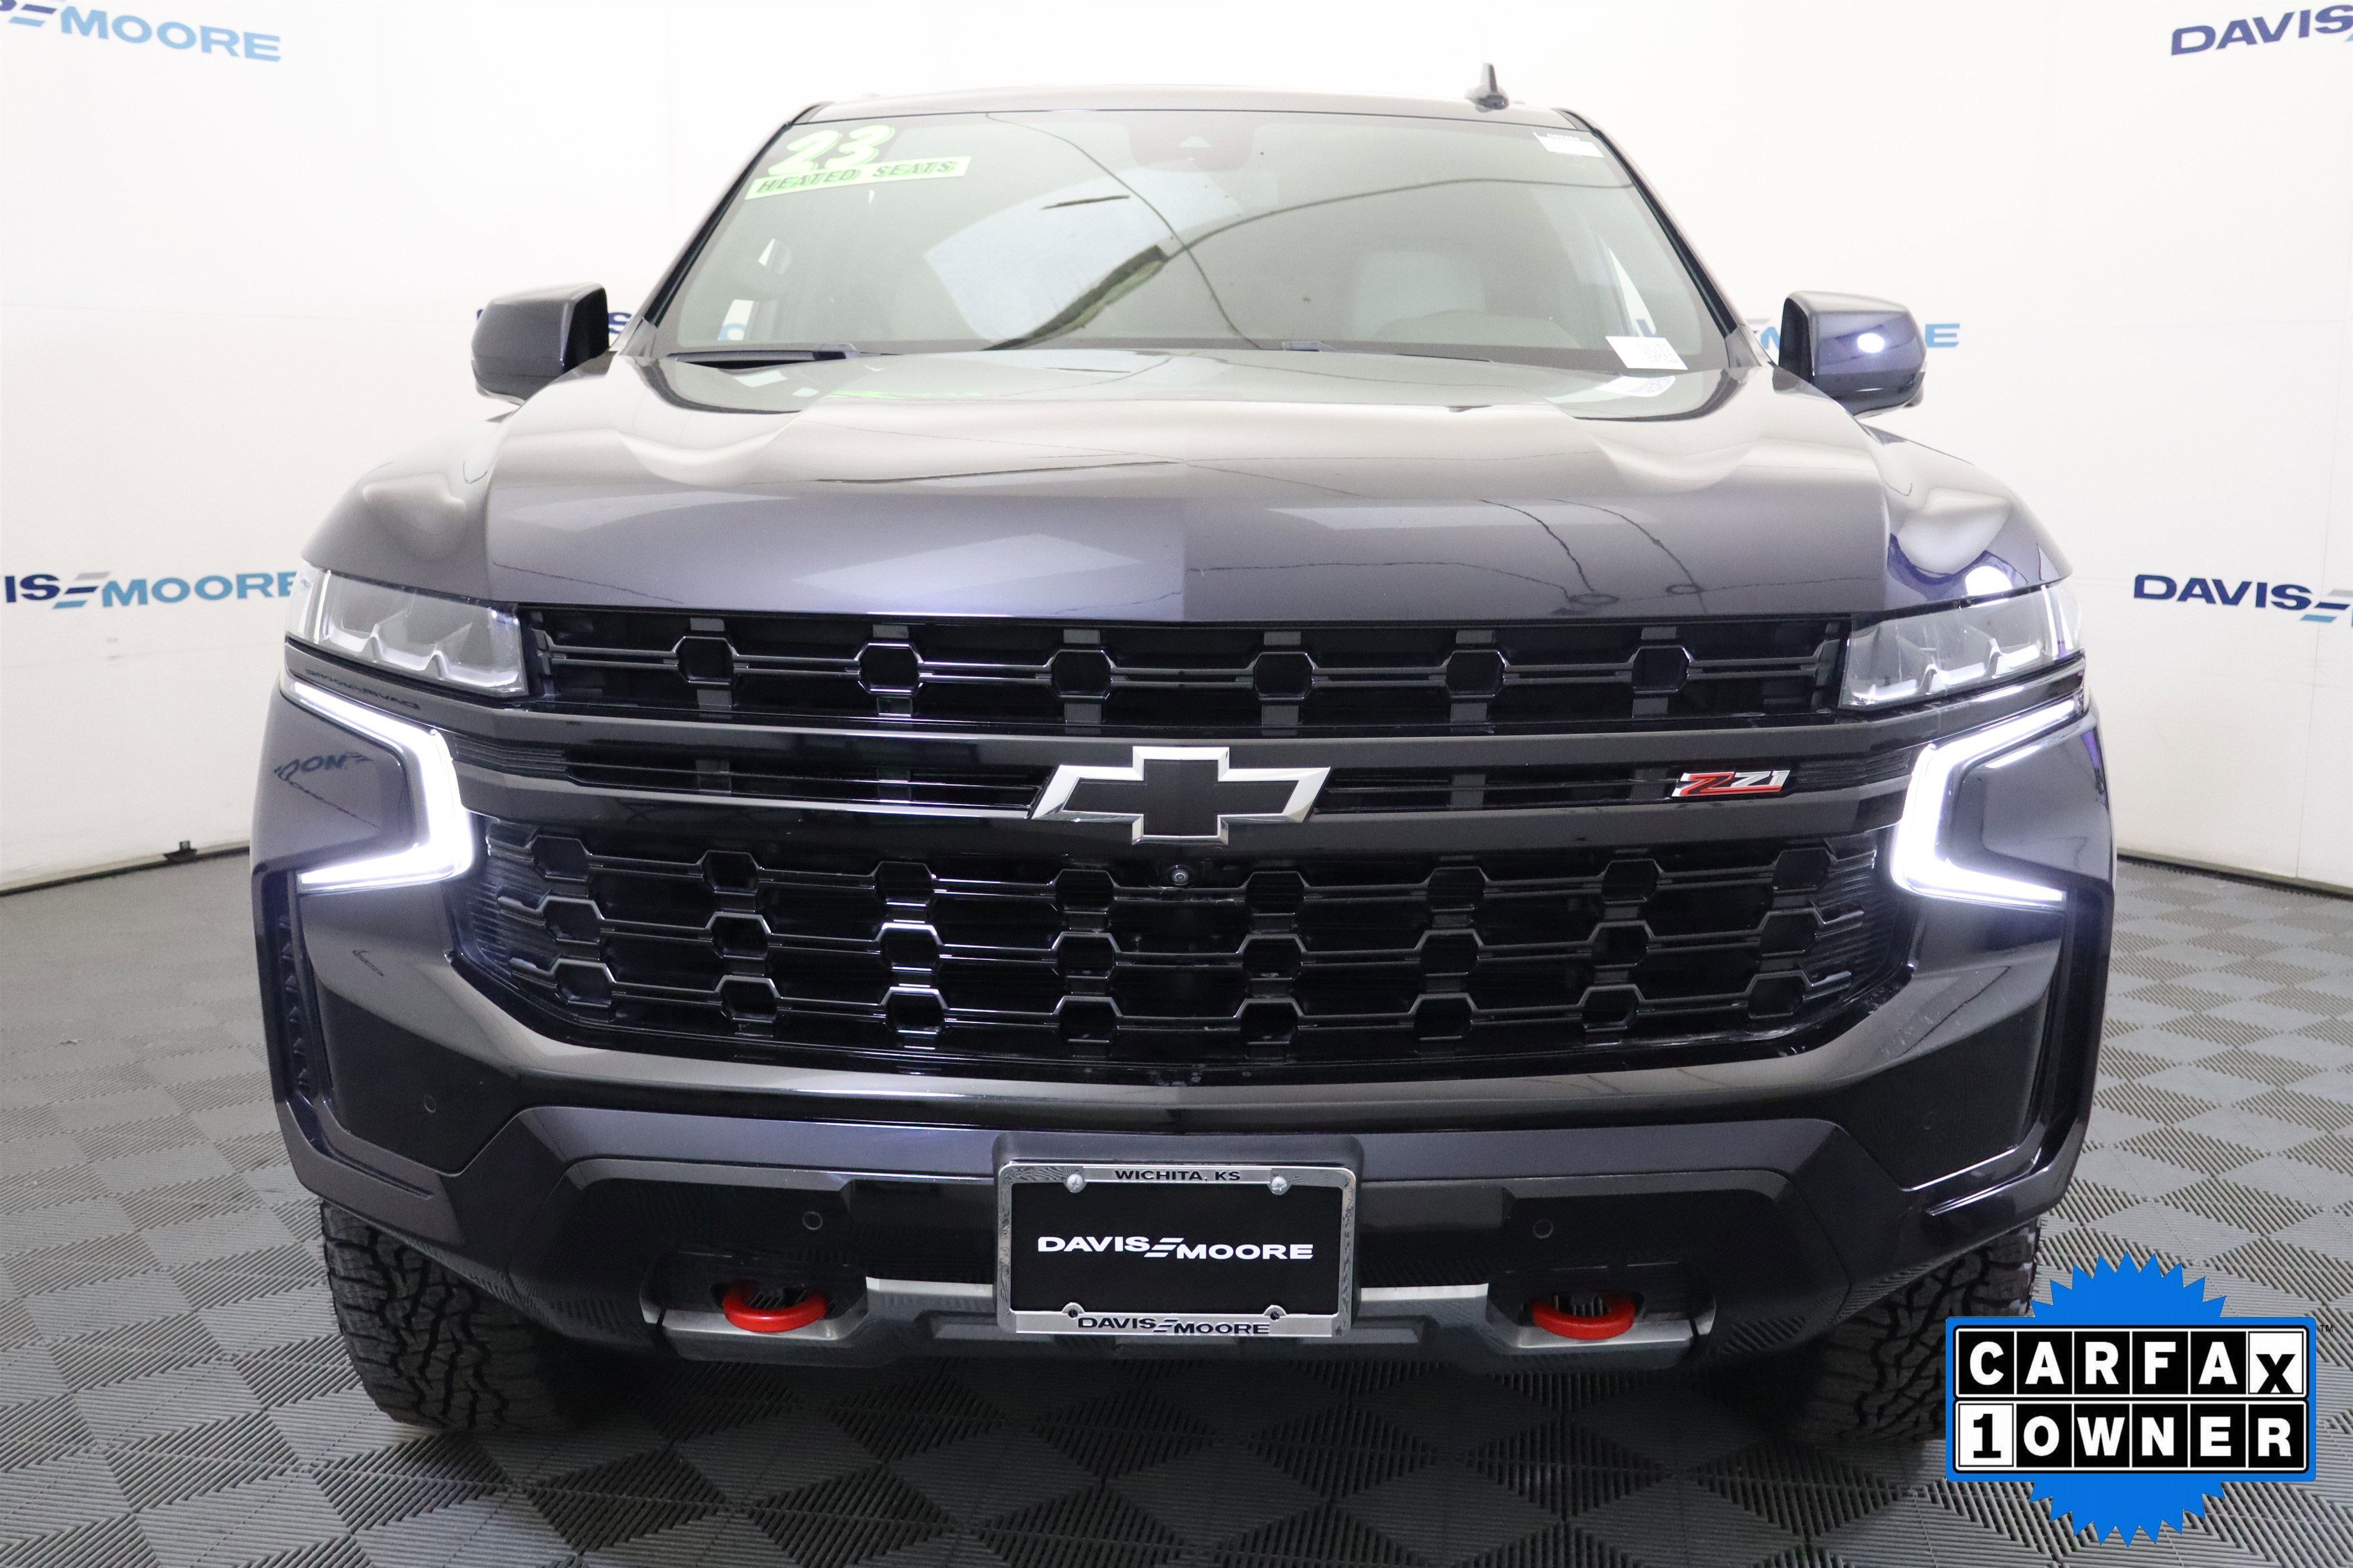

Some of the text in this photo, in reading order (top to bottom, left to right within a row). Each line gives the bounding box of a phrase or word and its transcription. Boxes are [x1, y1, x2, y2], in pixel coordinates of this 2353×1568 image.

[60, 6, 281, 61] MOORE
[2171, 5, 2353, 56] DAVIS
[768, 125, 895, 175] 23
[757, 161, 958, 194] HEATED SEATS
[2134, 574, 2312, 611] DAVIS
[1672, 770, 1791, 797] Z71
[1114, 1170, 1241, 1181] WICHITA, KS
[1037, 1236, 1314, 1260] DAVIS MOORE
[1078, 1318, 1271, 1334] DAVIS MOORE
